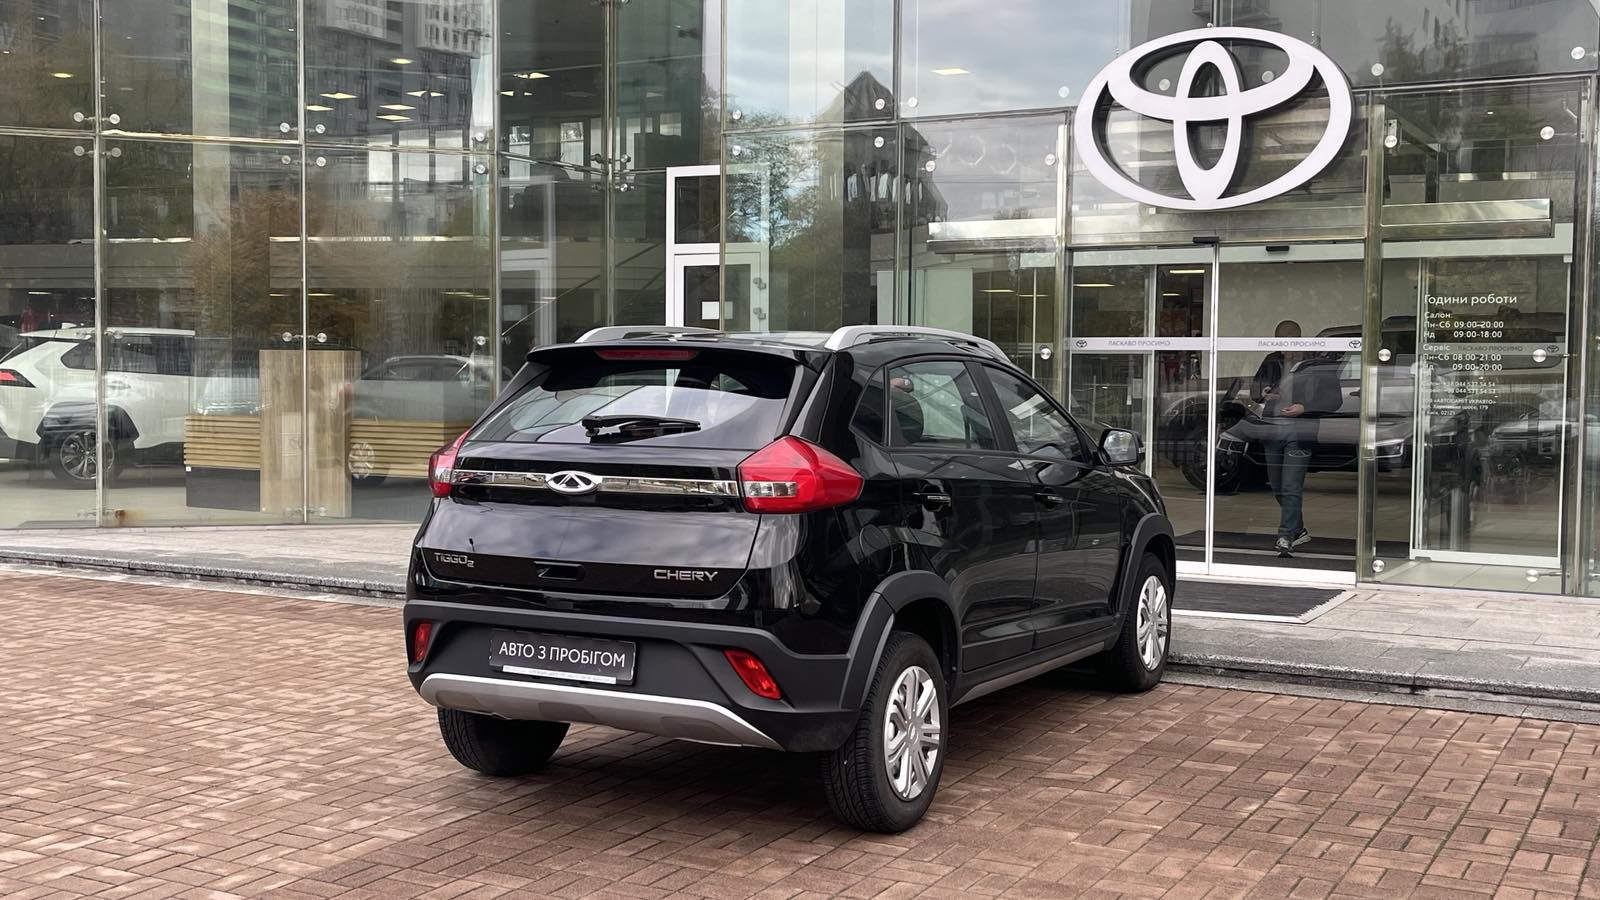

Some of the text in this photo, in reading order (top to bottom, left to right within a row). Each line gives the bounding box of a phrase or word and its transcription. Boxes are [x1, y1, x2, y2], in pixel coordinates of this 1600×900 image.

[1424, 293, 1518, 306] Години роботи
[1452, 353, 1502, 361] 08:00-21:00
[1452, 363, 1503, 371] 09:00-20:00
[653, 569, 719, 581] CHERY
[499, 641, 535, 658] АВТО
[549, 646, 626, 668] ПРОБІГОМ
